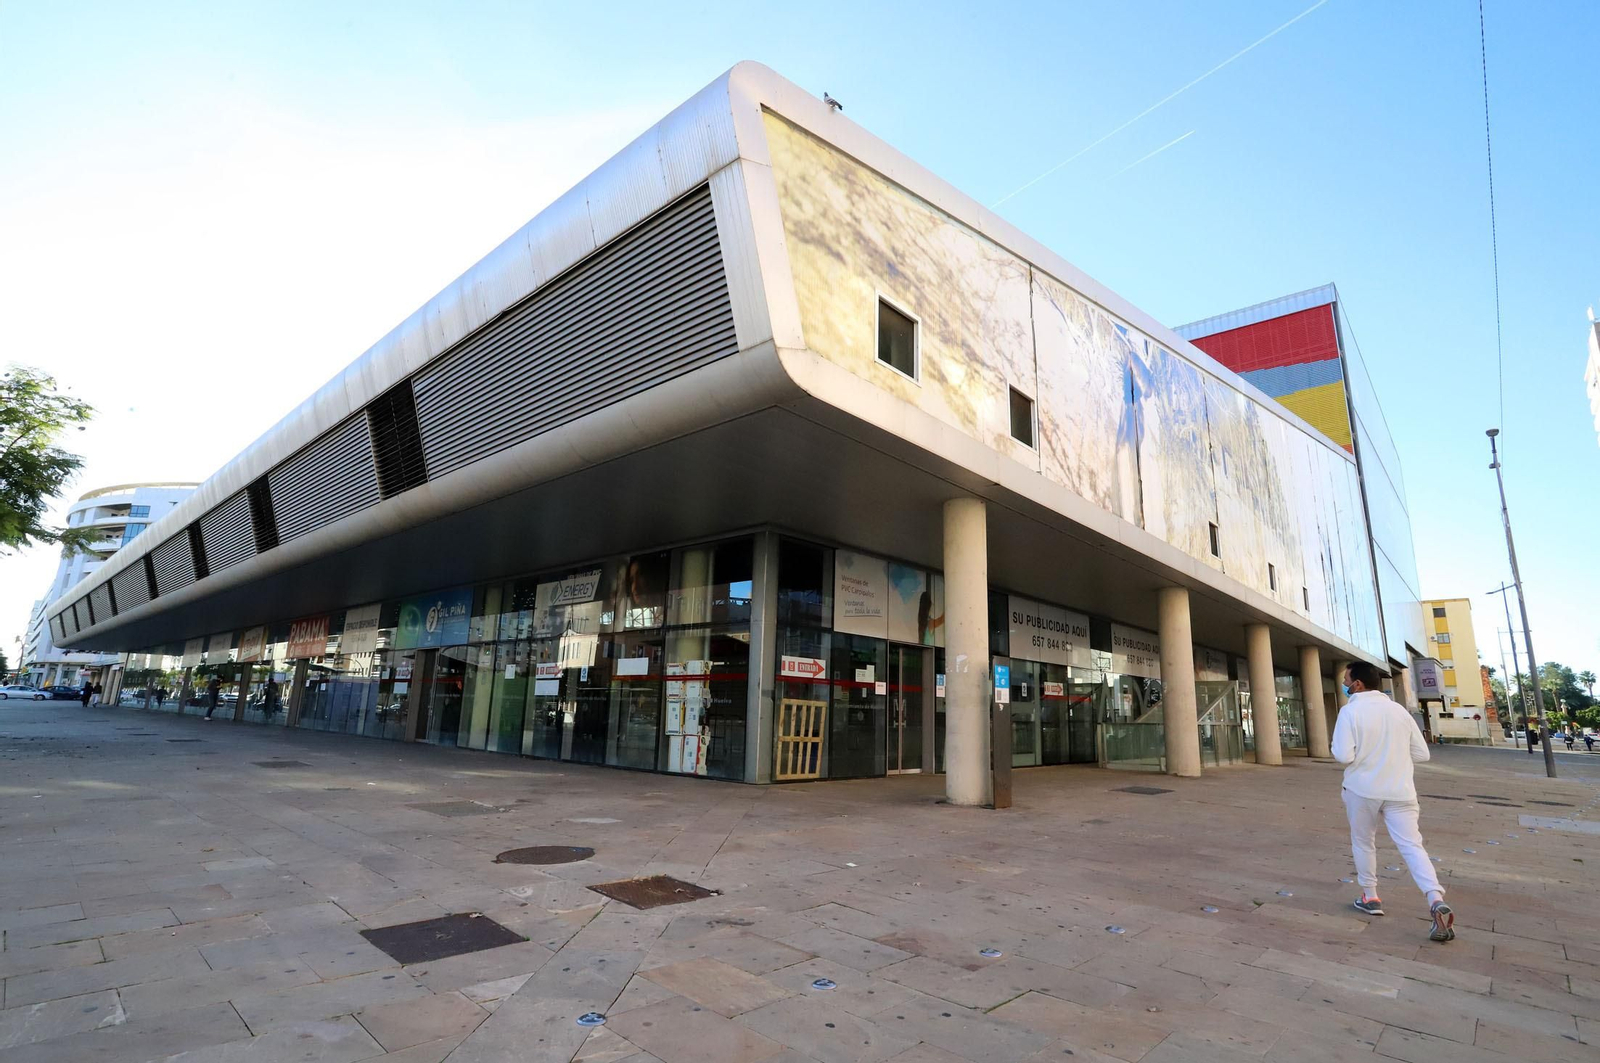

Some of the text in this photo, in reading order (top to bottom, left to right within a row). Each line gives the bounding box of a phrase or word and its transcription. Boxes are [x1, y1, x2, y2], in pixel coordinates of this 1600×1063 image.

[563, 581, 596, 598] ENERGY
[841, 584, 851, 594] PVC
[439, 602, 466, 618] GIL PIÑA
[1013, 612, 1088, 638] SU PUBLICIDAD AQUÍ
[1032, 635, 1045, 648] 657
[1046, 638, 1060, 650] 844
[1113, 635, 1122, 647] SU
[1122, 637, 1151, 653] PUBLICIDAD
[799, 663, 819, 673] ENTRADA
